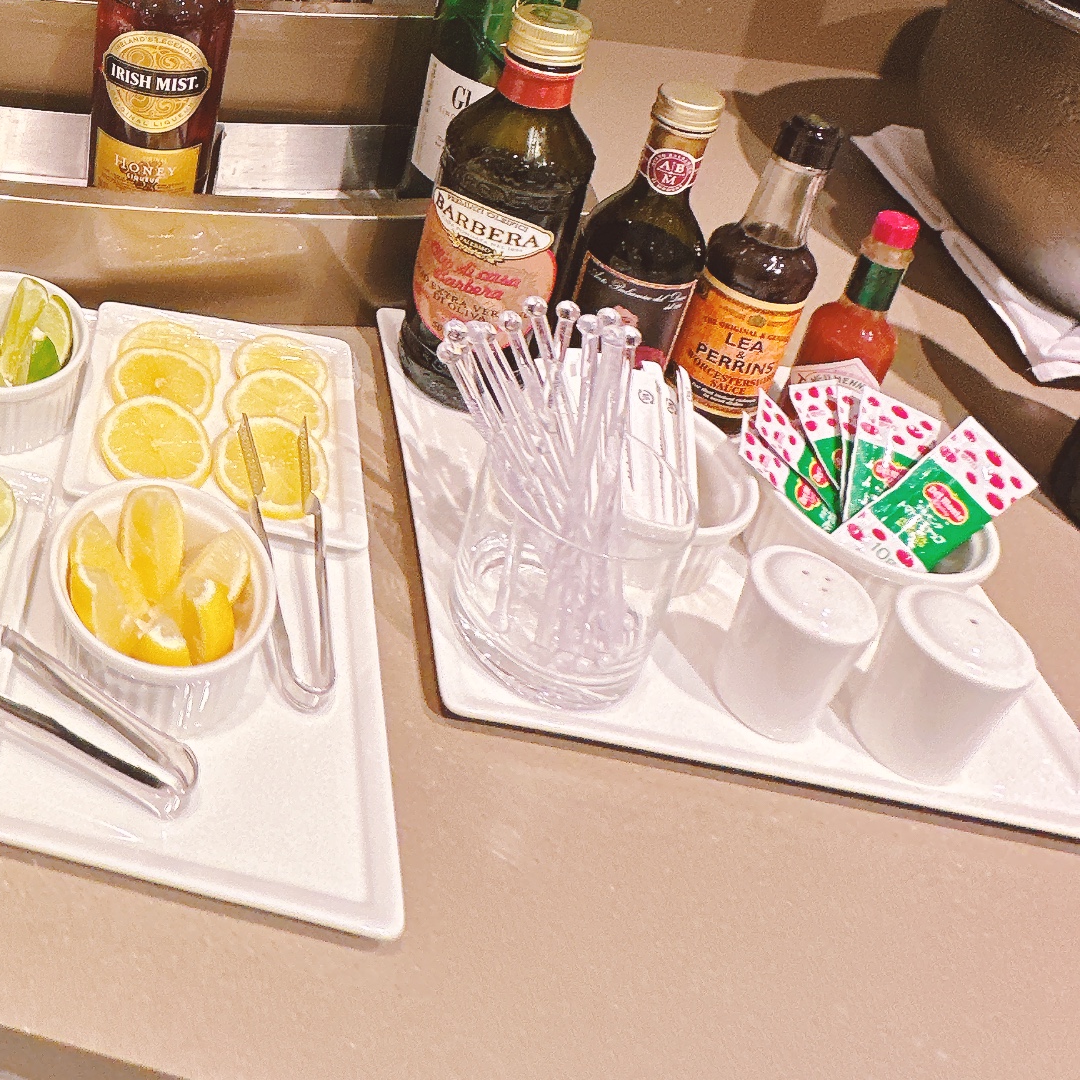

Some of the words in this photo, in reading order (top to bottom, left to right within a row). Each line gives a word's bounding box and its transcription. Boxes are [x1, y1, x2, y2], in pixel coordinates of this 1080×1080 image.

[111, 62, 153, 90] IRISH
[113, 153, 178, 177] HONEY
[435, 191, 540, 248] BARBERA
[430, 281, 468, 309] EXTRA
[433, 267, 504, 301] Barbera
[447, 301, 487, 323] OLIVA
[724, 331, 764, 354] LEA
[735, 351, 746, 360] &
[695, 341, 776, 376] PERRINS
[709, 380, 748, 395] SAUCE
